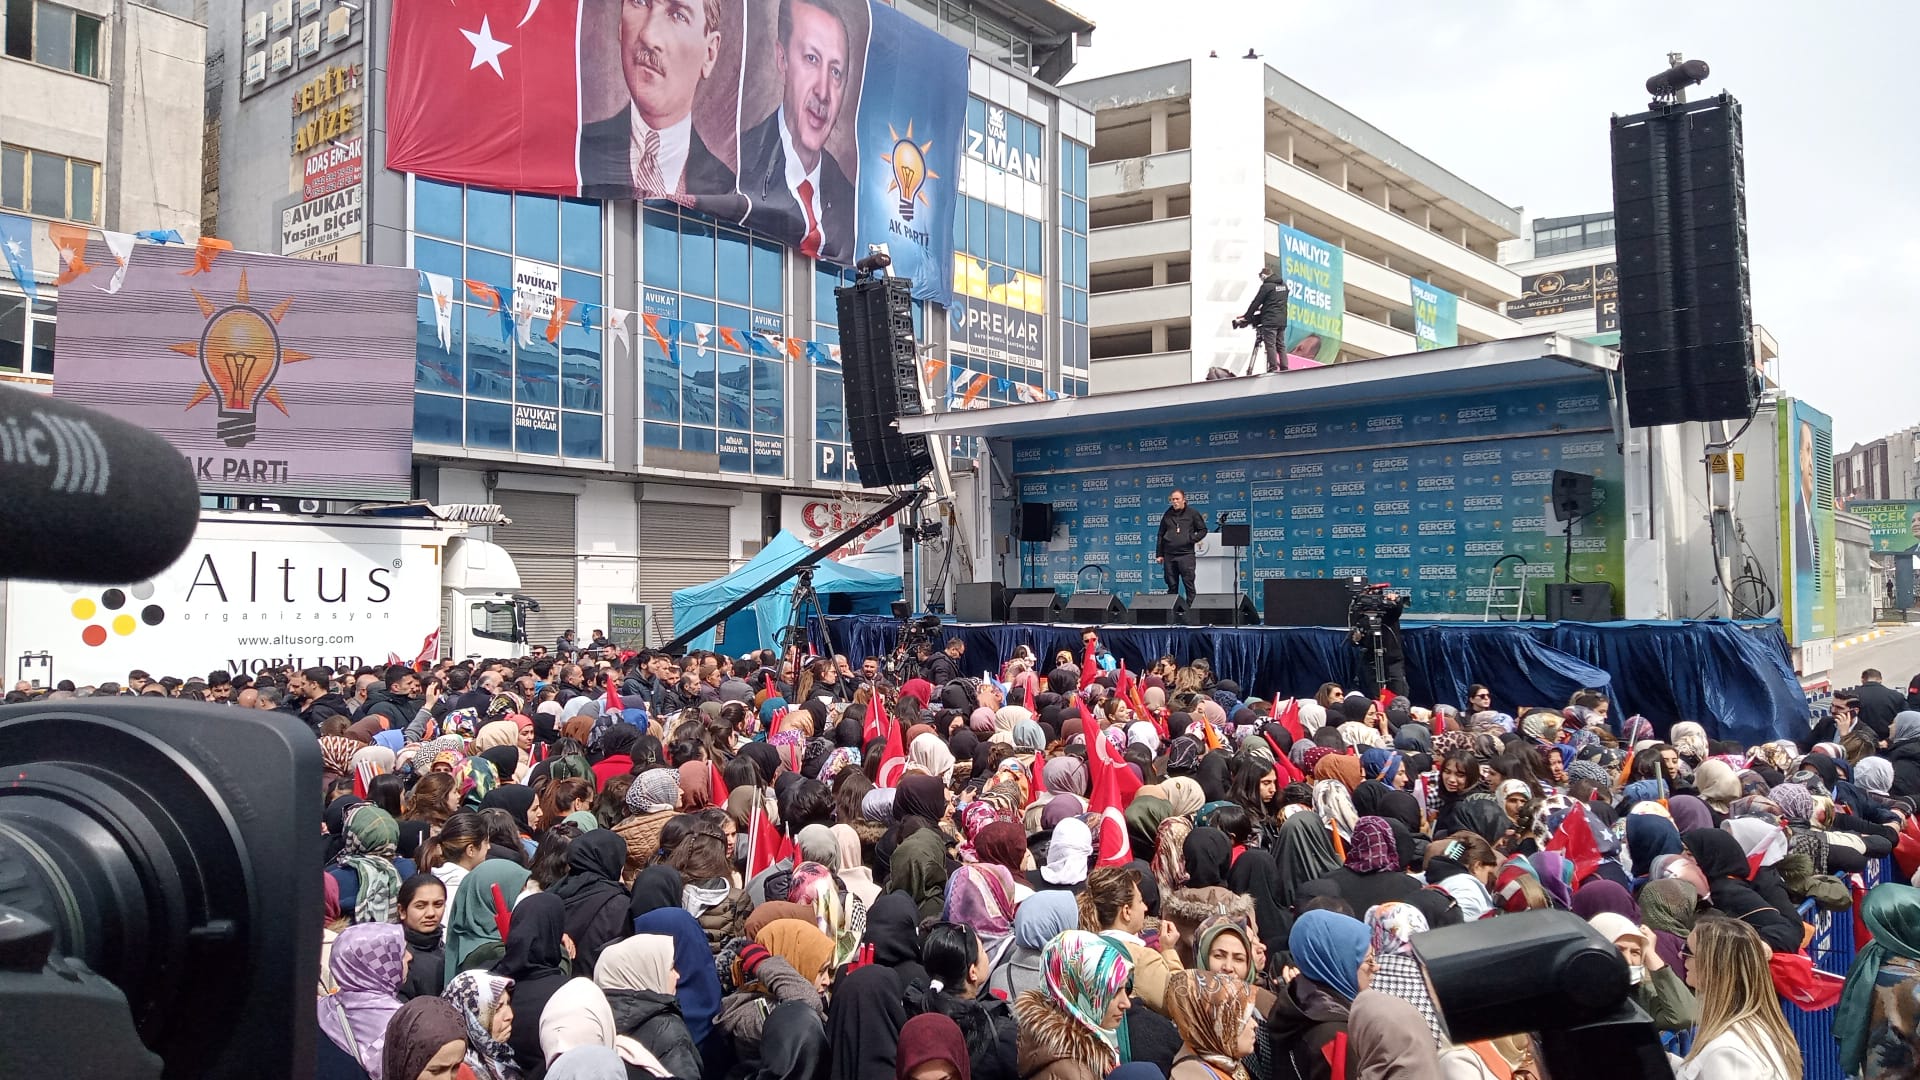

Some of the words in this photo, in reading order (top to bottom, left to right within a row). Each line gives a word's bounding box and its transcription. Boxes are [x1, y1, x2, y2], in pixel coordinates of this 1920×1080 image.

[301, 64, 347, 115] ELİT
[295, 104, 353, 153] AVİZE
[988, 123, 1006, 142] VAN
[306, 151, 328, 175] ADAŞ
[330, 138, 361, 168] EMAK
[968, 128, 1040, 183] ZMAN
[291, 188, 354, 225] AVUKAT
[284, 223, 319, 245] Yasin
[324, 207, 361, 232] BİÇER
[888, 218, 902, 236] AK
[904, 224, 928, 247] PARTİ
[1284, 234, 1330, 268] VANLIYIZ
[516, 273, 558, 292] AVUKAT
[646, 292, 674, 306] AVUKAT
[1562, 294, 1594, 302] HOTEL
[754, 316, 780, 328] AVUKAT
[968, 308, 1038, 344] PREMAR
[516, 407, 556, 422] AVUKAT
[516, 418, 532, 428] SIRRI
[532, 420, 557, 432] ÇAĞLAR
[223, 458, 288, 484] PARTİ
[186, 551, 390, 603] Altus
[184, 611, 389, 621] organizasyon
[238, 634, 354, 646] www.altusorg.com
